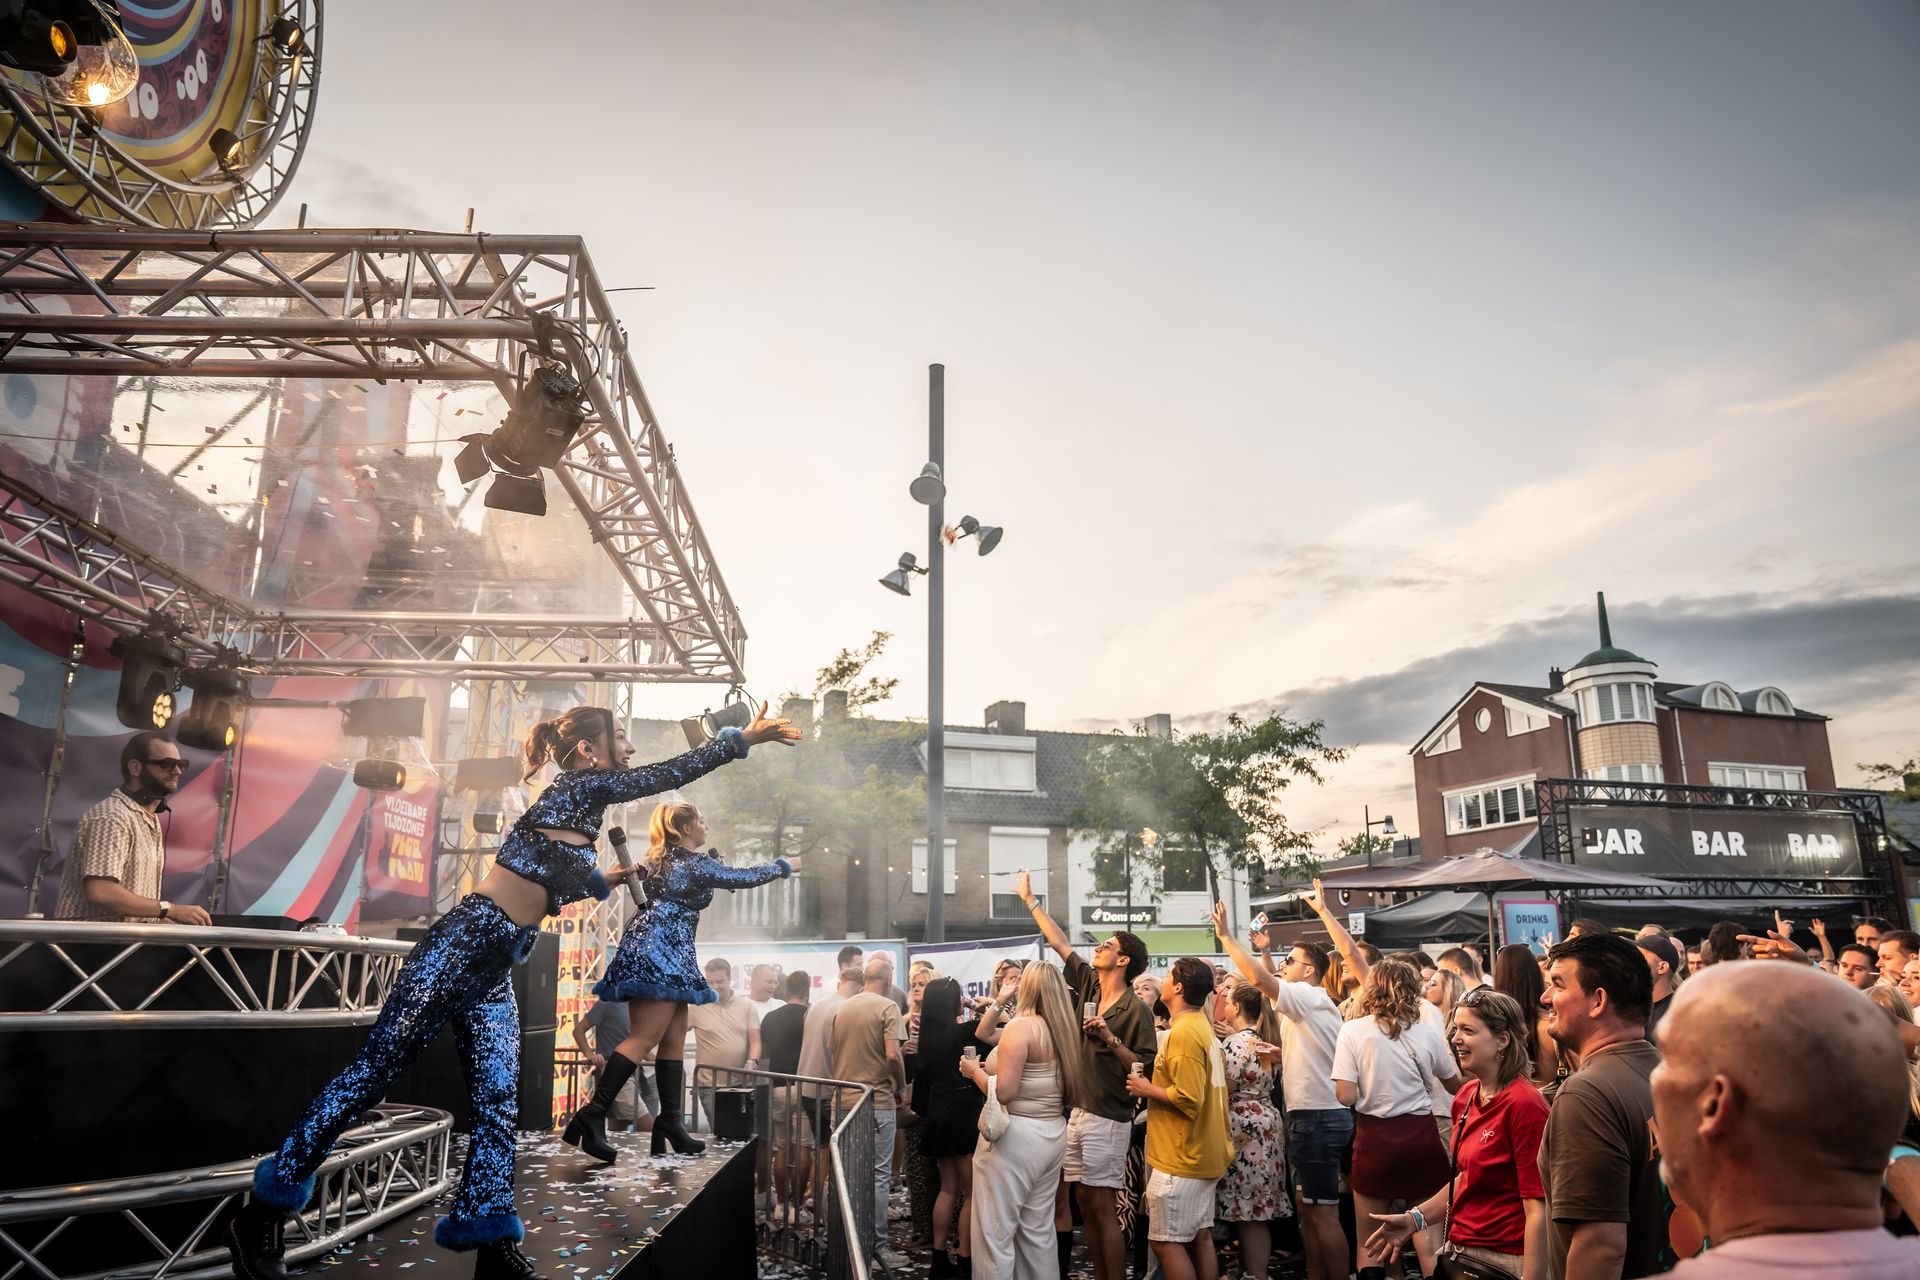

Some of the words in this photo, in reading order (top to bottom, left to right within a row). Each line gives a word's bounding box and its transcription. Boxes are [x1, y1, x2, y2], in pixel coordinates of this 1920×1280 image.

[385, 795, 428, 822] VLOEIBARE
[384, 812, 425, 838] TIJDZONES
[1586, 828, 1645, 855] BAR
[1692, 830, 1748, 856] BAR
[1787, 833, 1841, 858] BAR
[1102, 911, 1152, 922] Domno's
[1516, 914, 1549, 924] DRINKS
